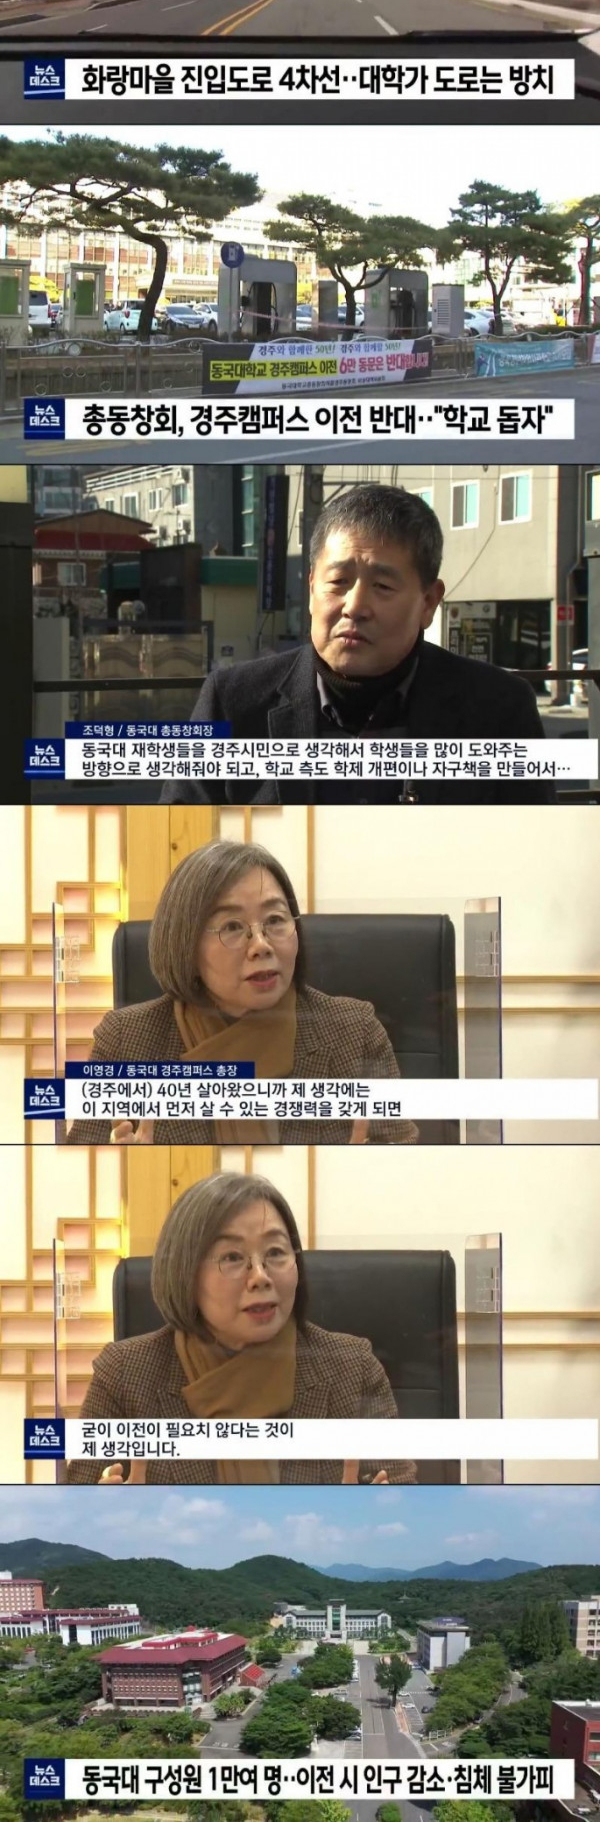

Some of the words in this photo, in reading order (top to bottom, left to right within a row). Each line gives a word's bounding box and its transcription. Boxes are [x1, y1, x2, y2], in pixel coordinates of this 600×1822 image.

[258, 346, 286, 356] 경주와
[211, 362, 267, 379] 동국대학교
[269, 361, 317, 378] 경주캠퍼스
[319, 360, 337, 375] 이전
[339, 357, 355, 374] 6만
[358, 356, 384, 373] 동문은
